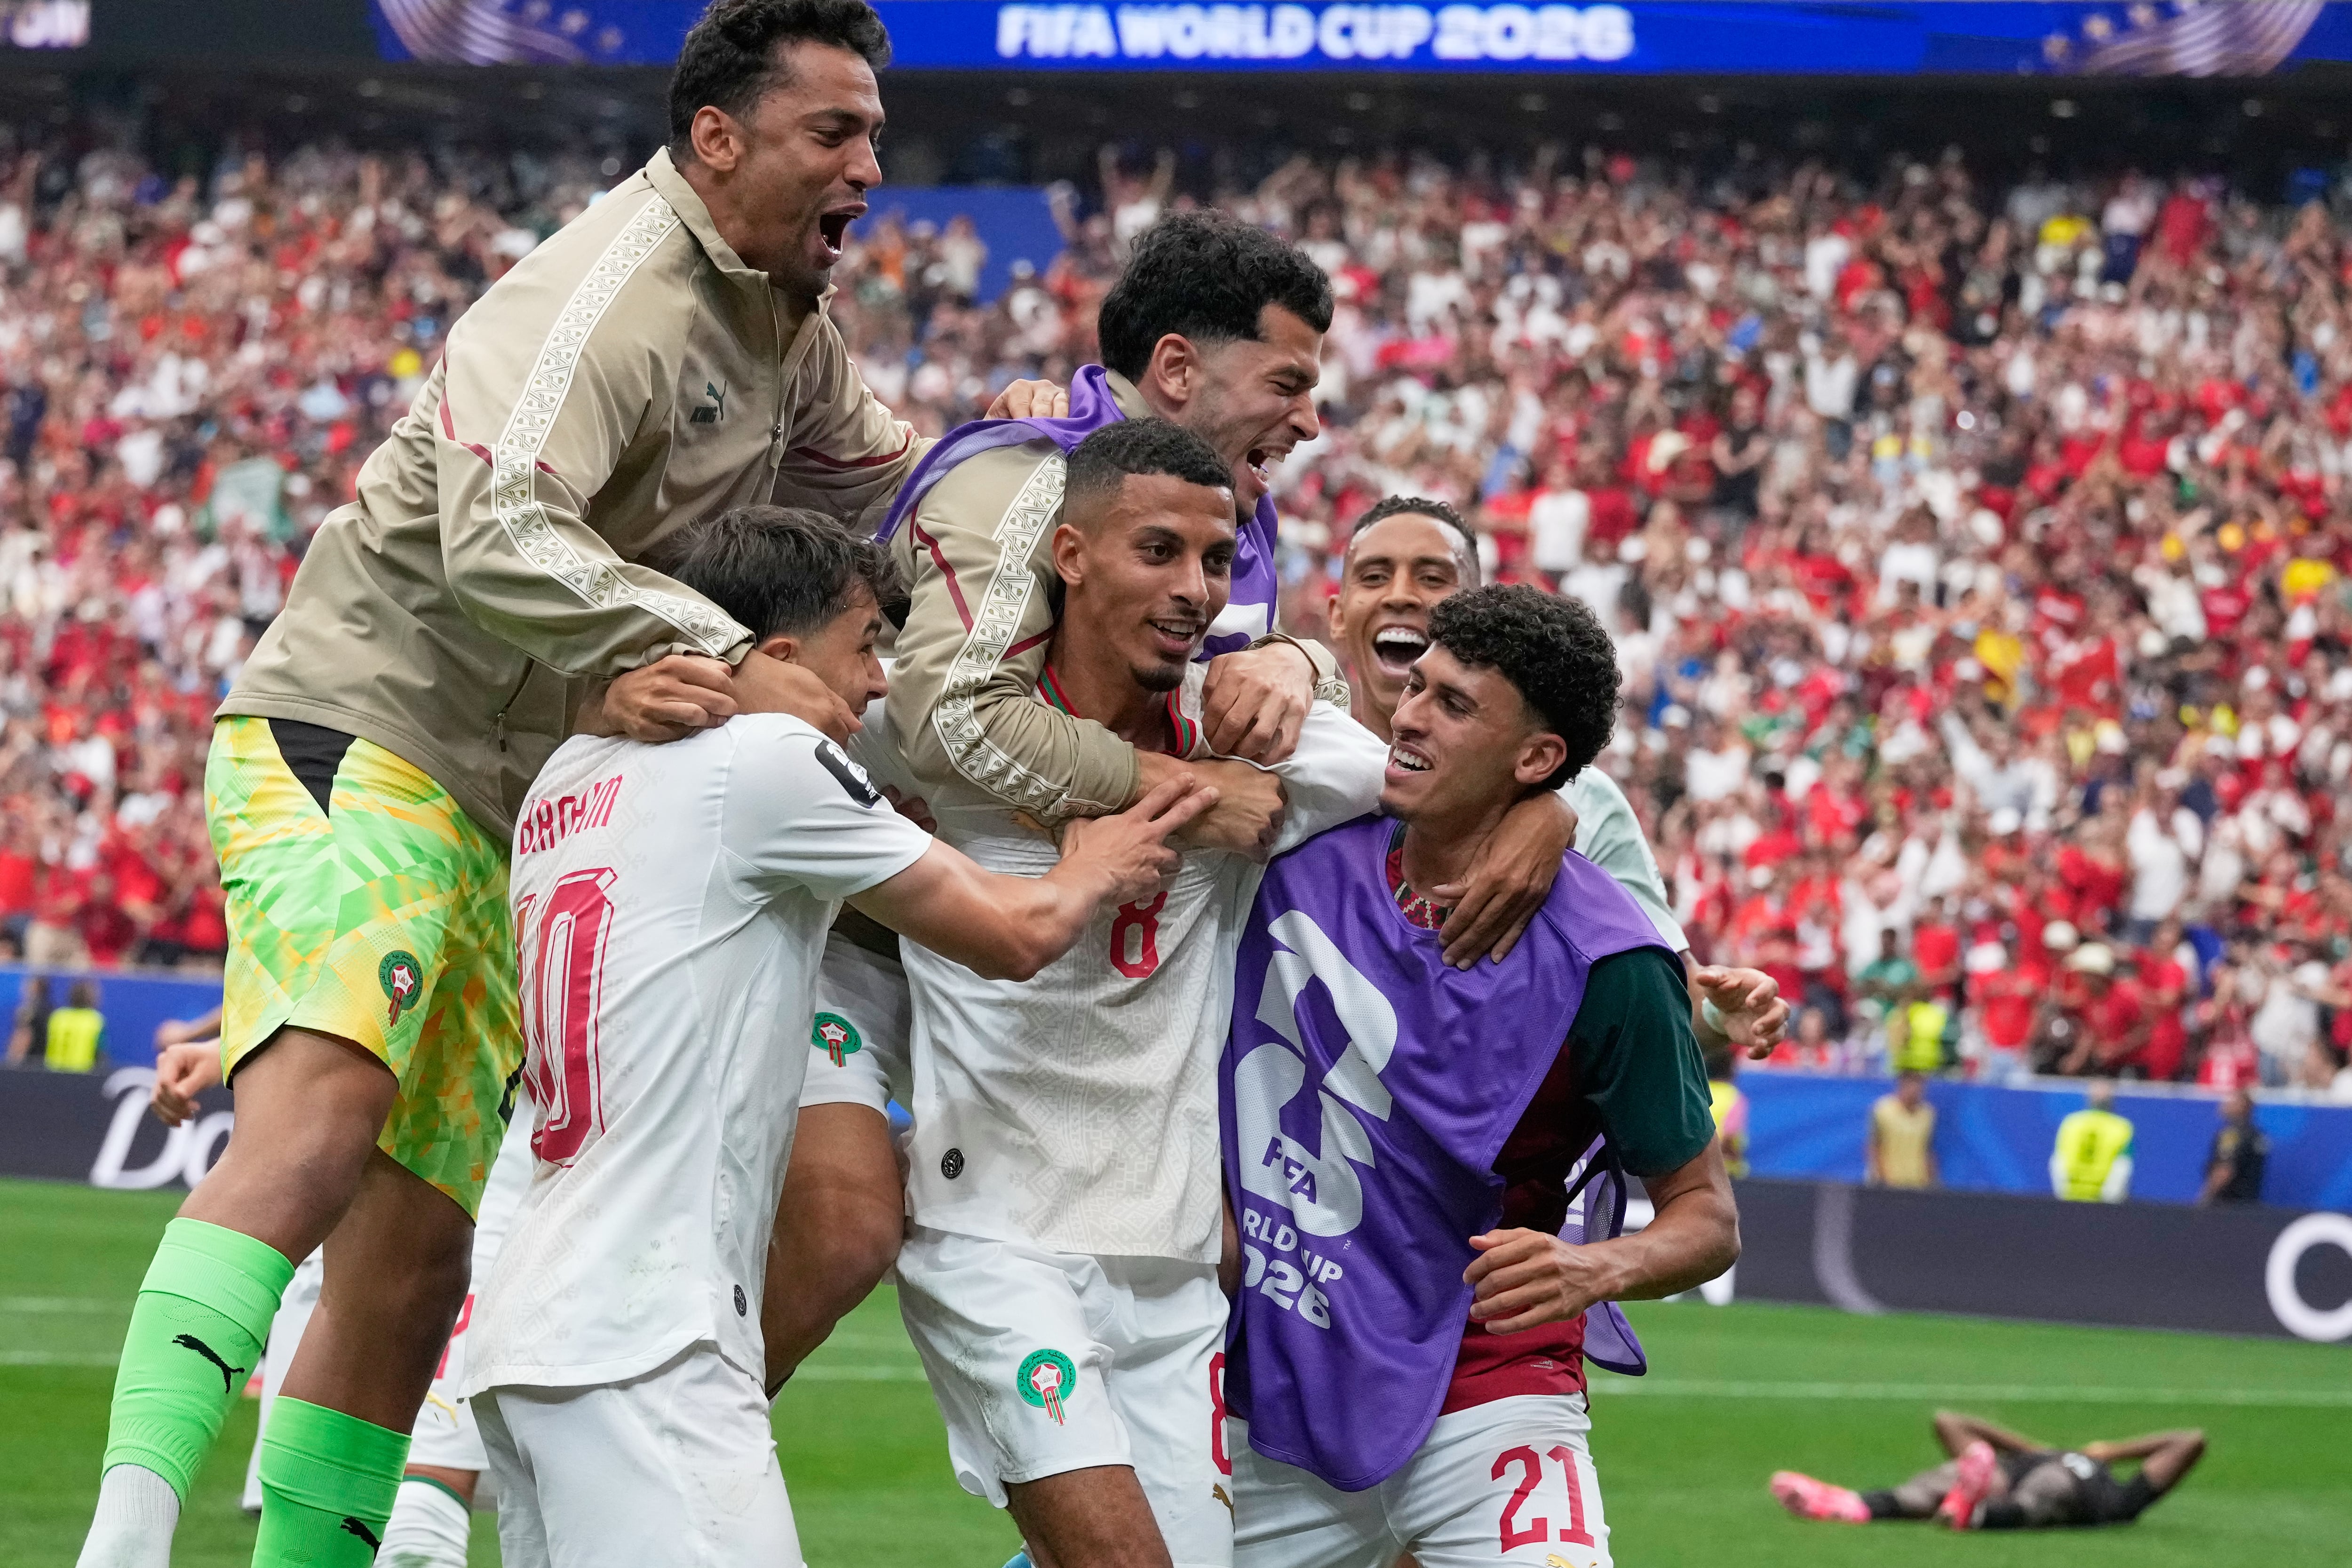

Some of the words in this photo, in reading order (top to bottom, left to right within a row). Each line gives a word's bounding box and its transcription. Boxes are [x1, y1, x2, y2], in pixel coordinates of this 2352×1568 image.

[996, 4, 1118, 58] FIFA
[1120, 4, 1316, 59] WORLD
[1318, 4, 1431, 59] CUP
[1432, 5, 1635, 60] 2026
[1110, 891, 1168, 978] 8
[1262, 1136, 1317, 1205] FFA
[1243, 1207, 1298, 1252] RLD
[1301, 1245, 1343, 1284] UP
[1244, 1242, 1331, 1330] 026
[1491, 1444, 1595, 1554] 21
